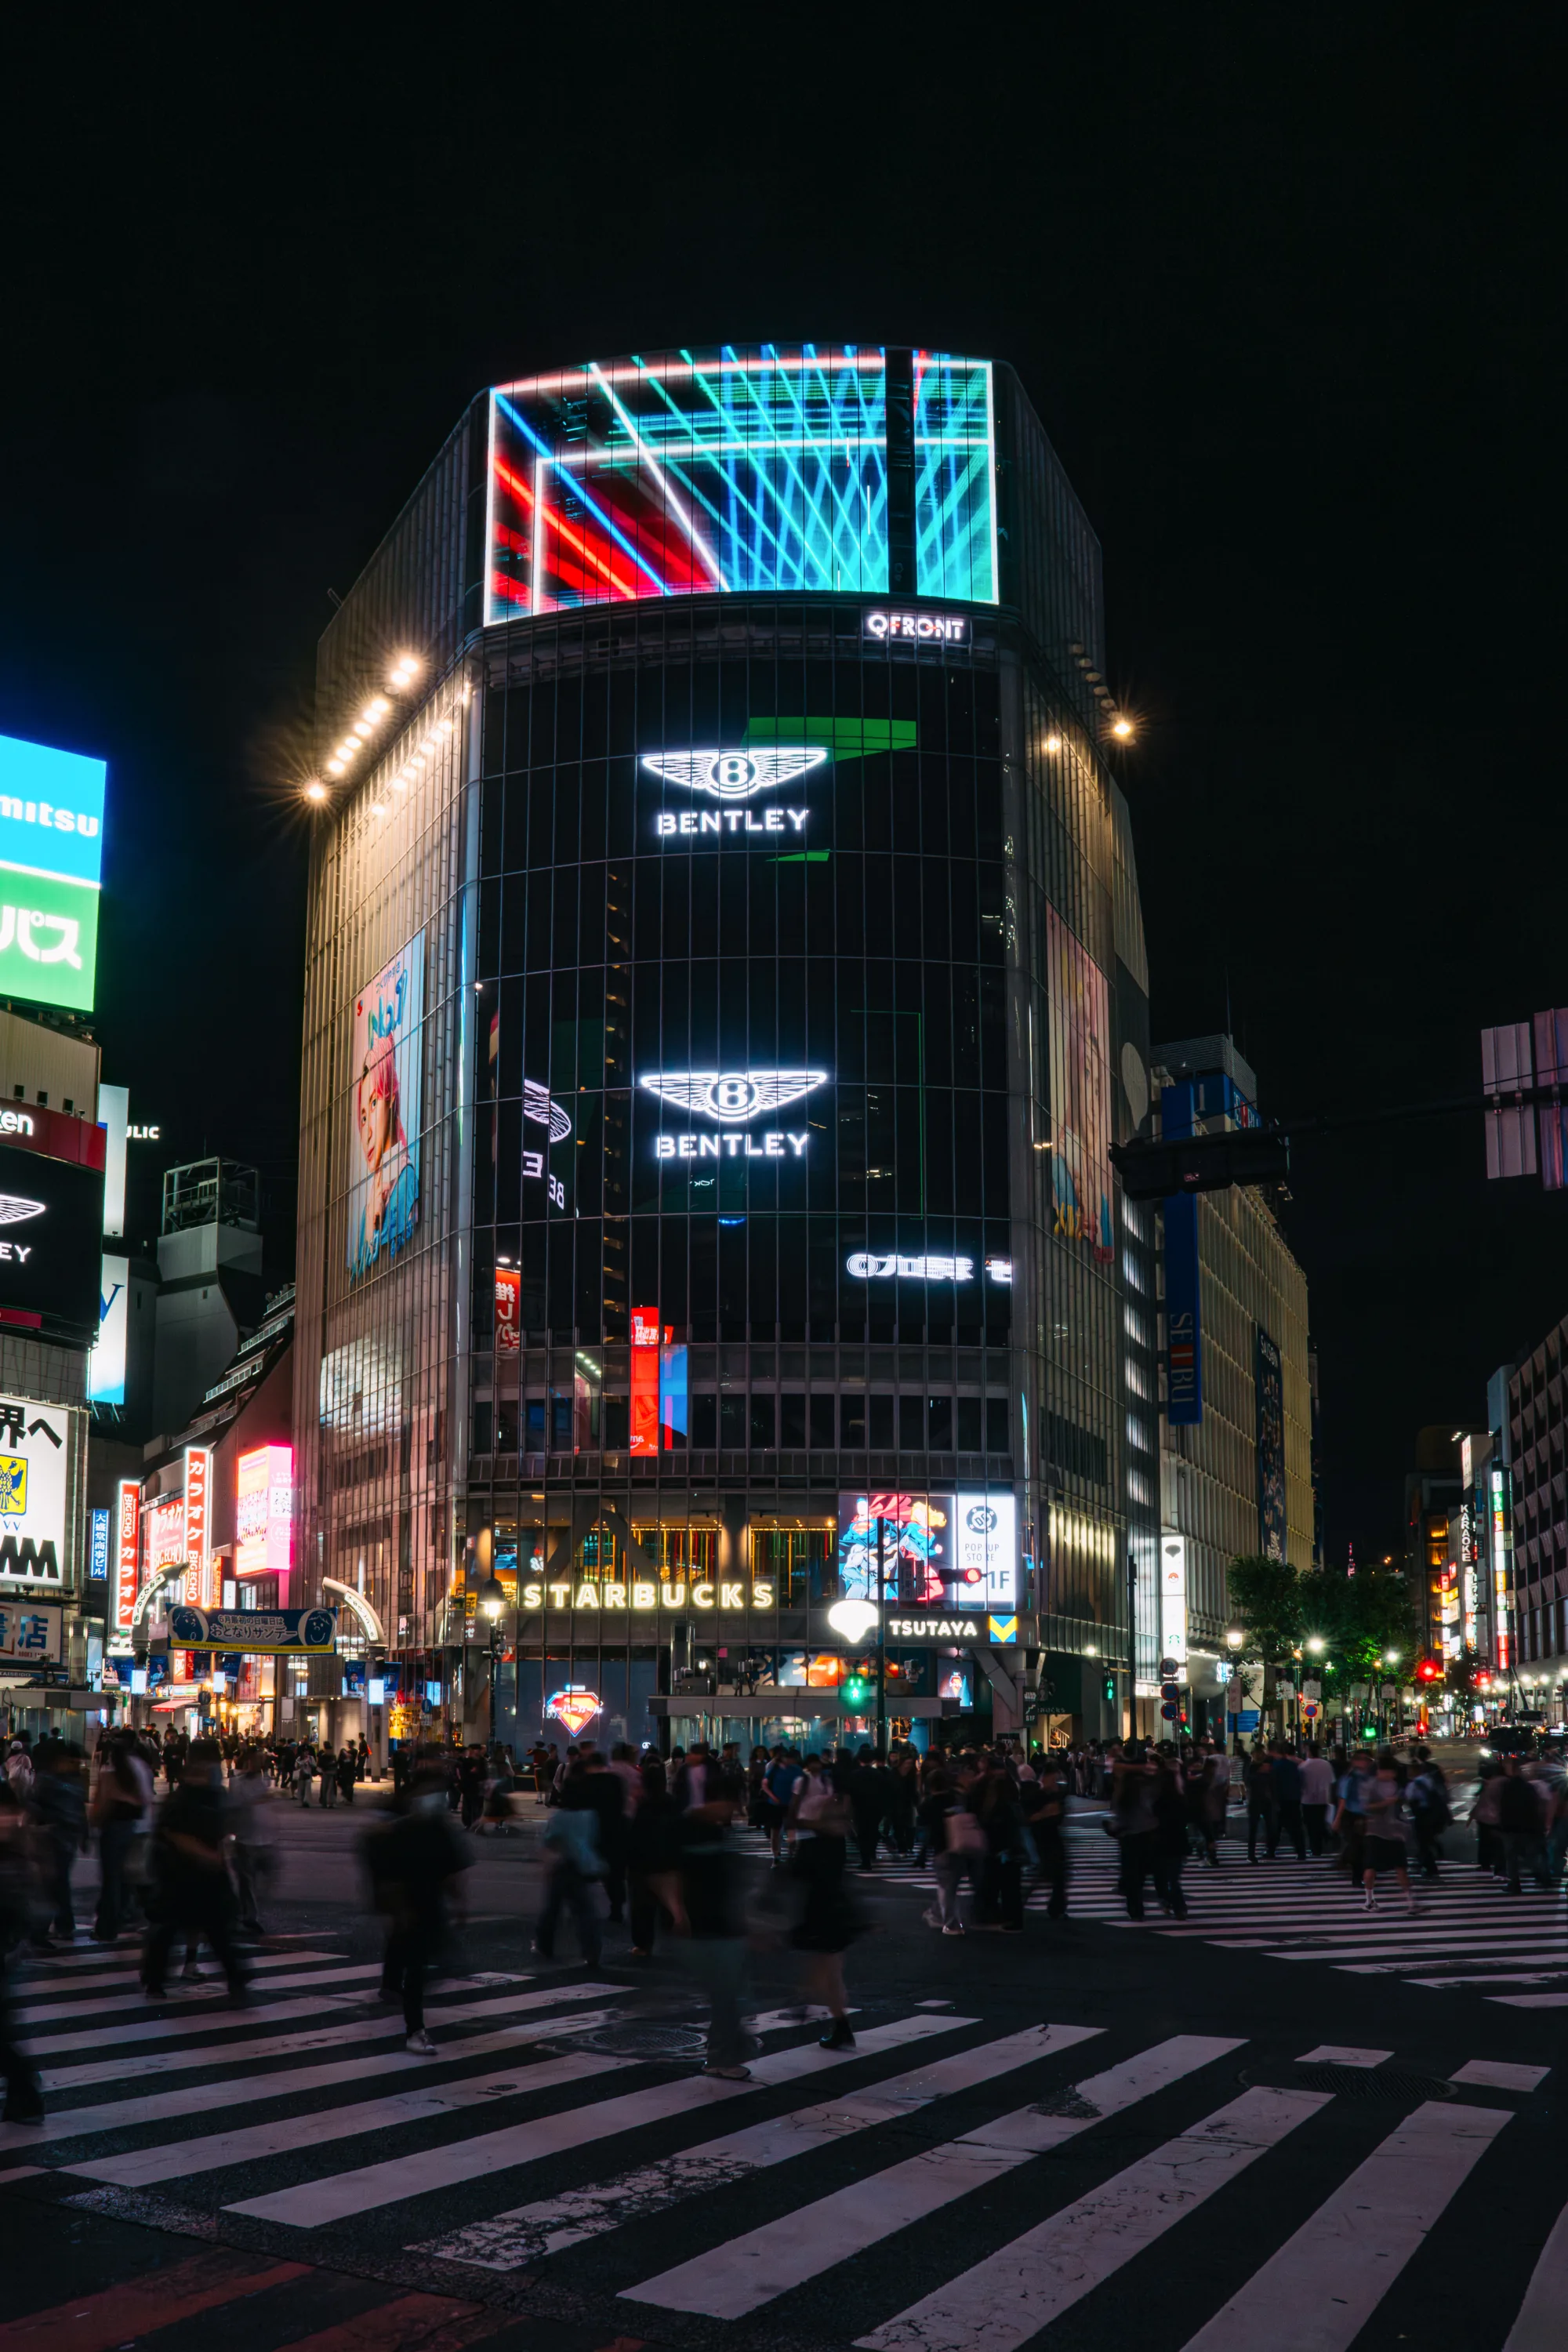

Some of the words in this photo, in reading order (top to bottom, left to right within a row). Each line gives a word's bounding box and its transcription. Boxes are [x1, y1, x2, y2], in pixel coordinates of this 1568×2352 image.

[867, 614, 964, 640] QFRONT
[657, 808, 810, 835] BENTLEY
[0, 1110, 34, 1136] en
[655, 1133, 810, 1159] BENTLEY
[1170, 1312, 1195, 1403] SEIBU
[123, 1494, 134, 1513] BIG
[187, 1461, 205, 1541] カラオケ
[122, 1513, 133, 1539] ECHO
[1460, 1504, 1472, 1562] KARAOKE
[93, 1513, 107, 1576] 大盛堂商事ビル
[964, 1543, 982, 1552] POP
[187, 1550, 199, 1573] BIG
[119, 1546, 135, 1617] カラオケ
[186, 1573, 198, 1602] ECHO
[524, 1583, 773, 1609] STARBUCKS
[210, 1623, 298, 1639] おとなりサンデー
[889, 1621, 978, 1636] TSUTAYA
